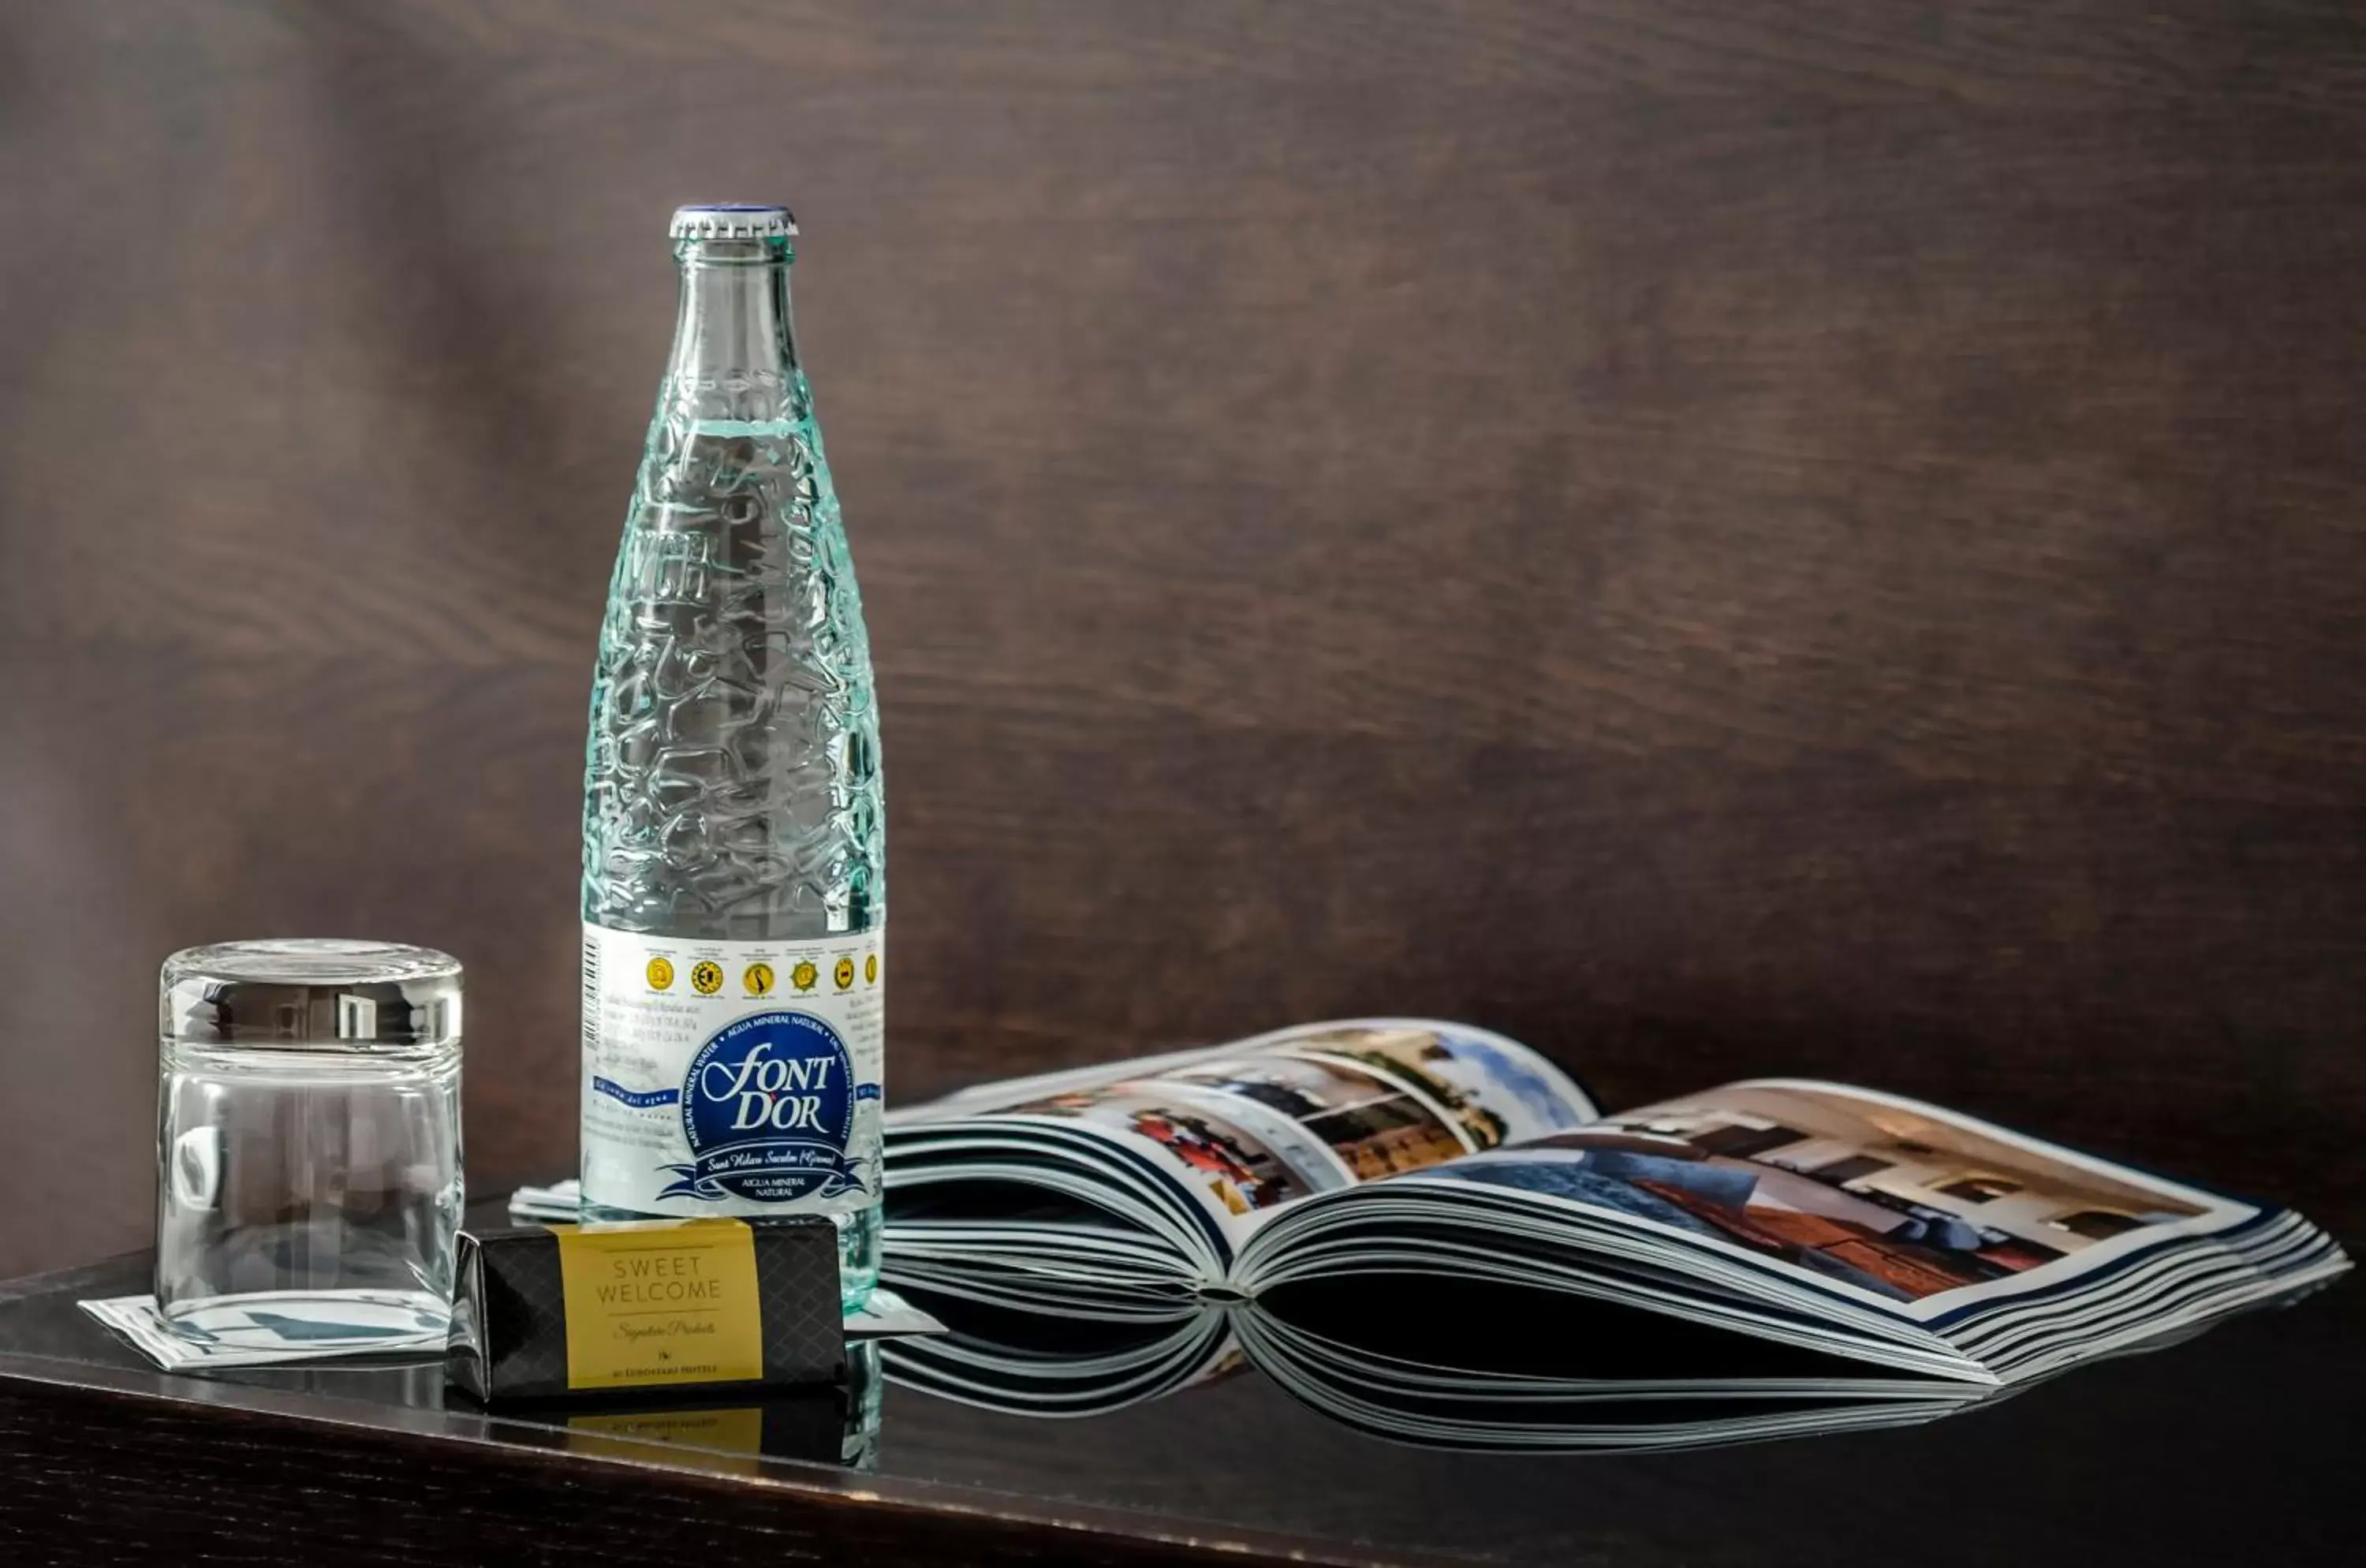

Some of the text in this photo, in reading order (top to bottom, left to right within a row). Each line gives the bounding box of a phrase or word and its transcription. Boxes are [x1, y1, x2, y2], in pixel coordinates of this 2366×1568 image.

[727, 1015, 824, 1038] AGUA MINERAL NATURAL
[684, 1041, 720, 1148] NATURAL MINERAL WATER
[730, 1091, 830, 1133] D'OR
[755, 1189, 793, 1197] NATURAL
[771, 1178, 805, 1187] MINERAL
[613, 1256, 701, 1279] SWEET
[596, 1279, 722, 1307] WELCOME
